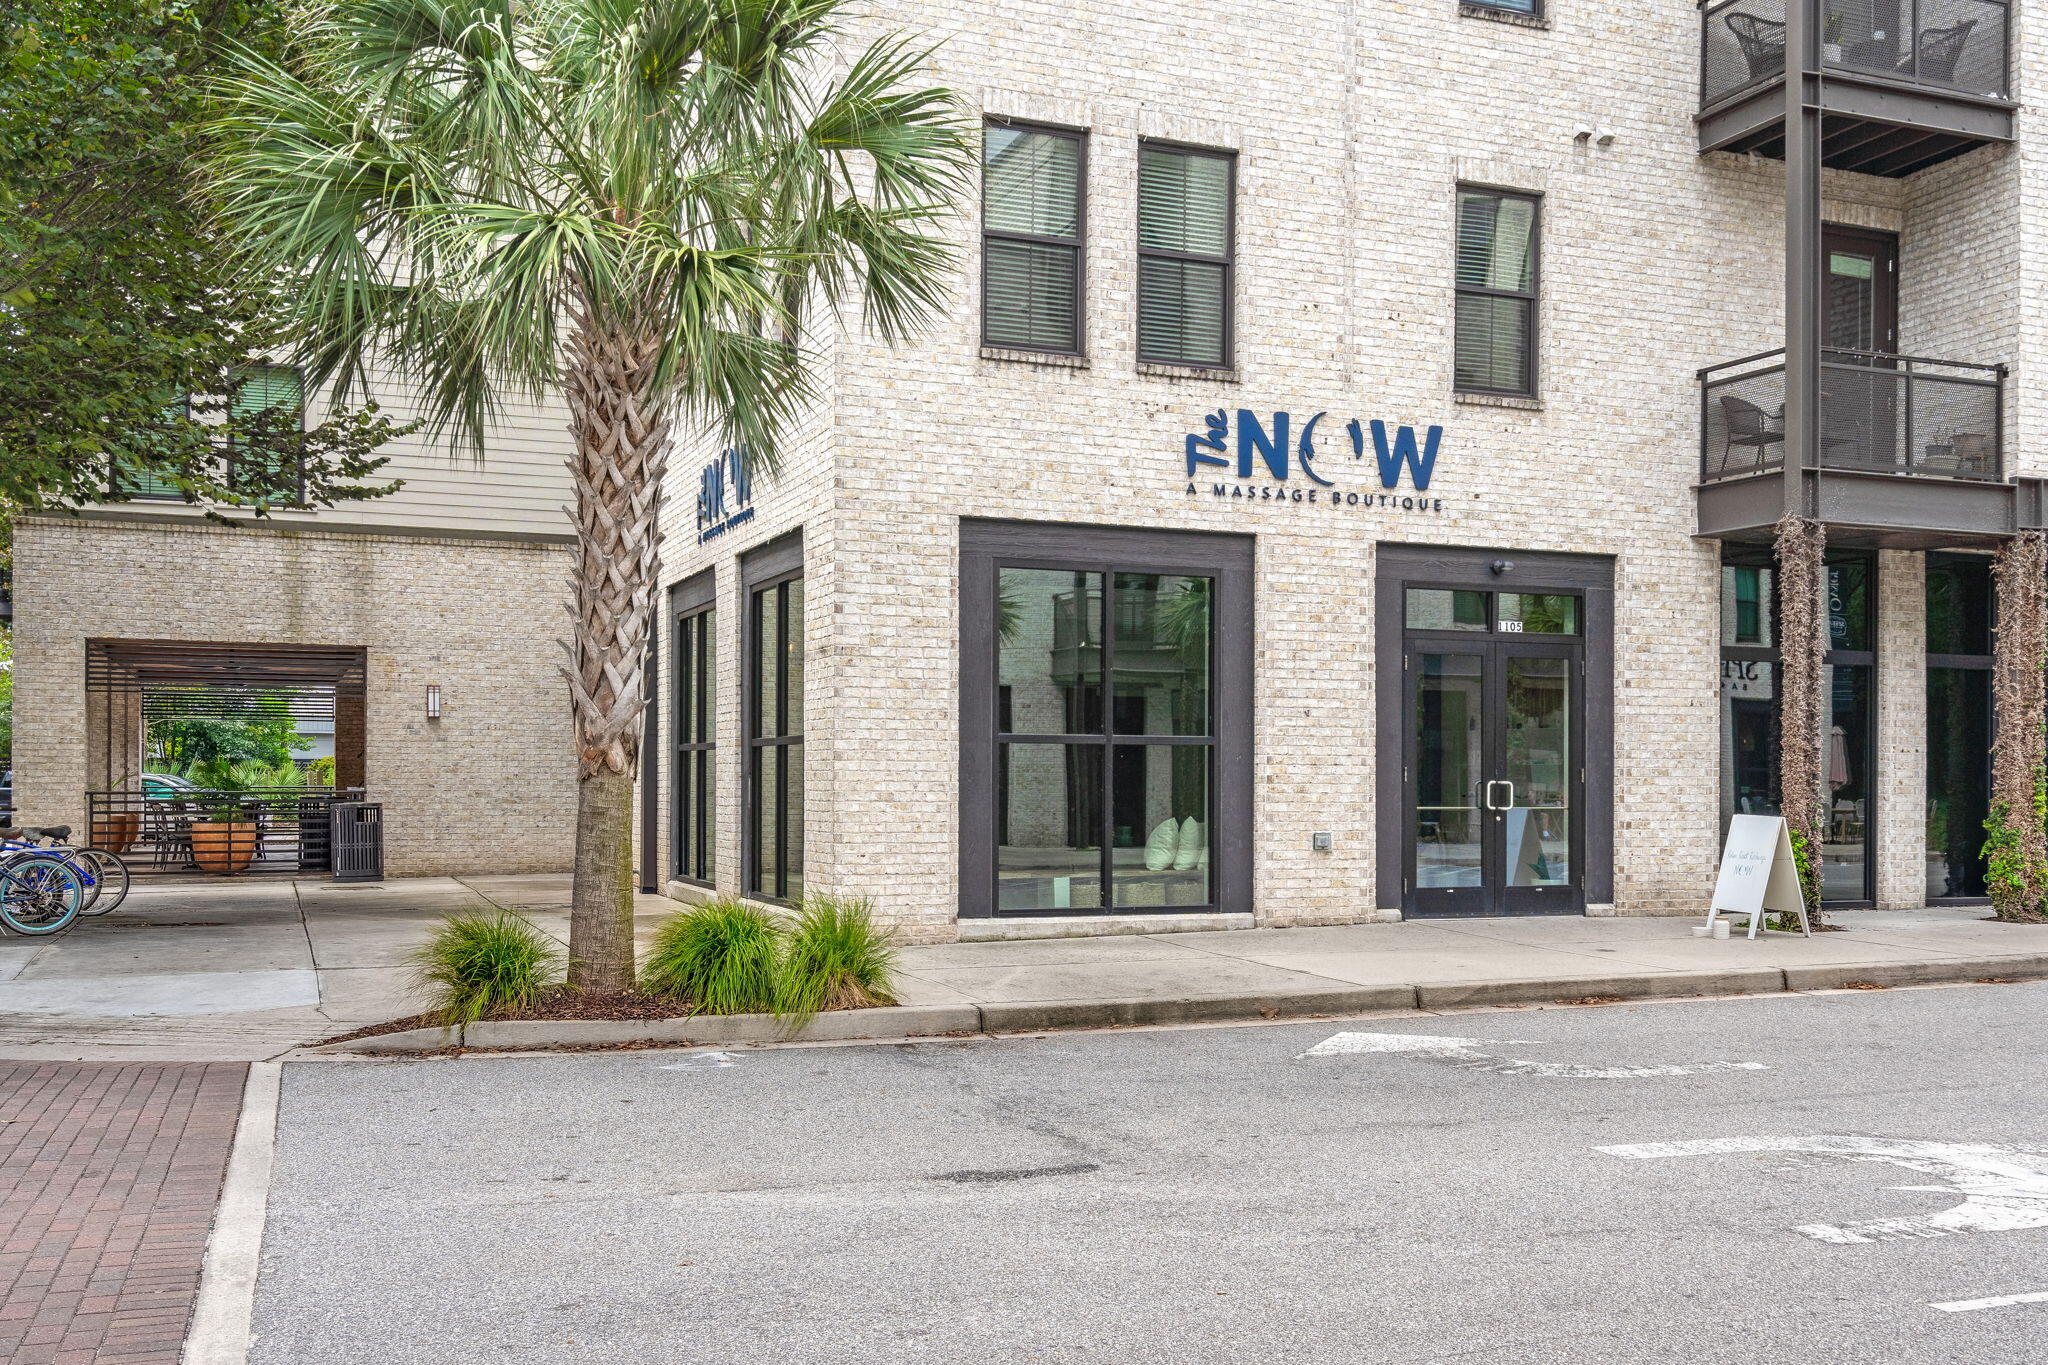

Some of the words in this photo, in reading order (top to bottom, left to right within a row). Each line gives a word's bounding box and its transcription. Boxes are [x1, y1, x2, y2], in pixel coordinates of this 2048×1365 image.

[1237, 408, 1443, 491] NOW
[1186, 482, 1197, 496] A
[1213, 483, 1317, 502] MASSAGE
[1332, 491, 1442, 512] BOUTIQUE
[1499, 622, 1522, 632] 1105
